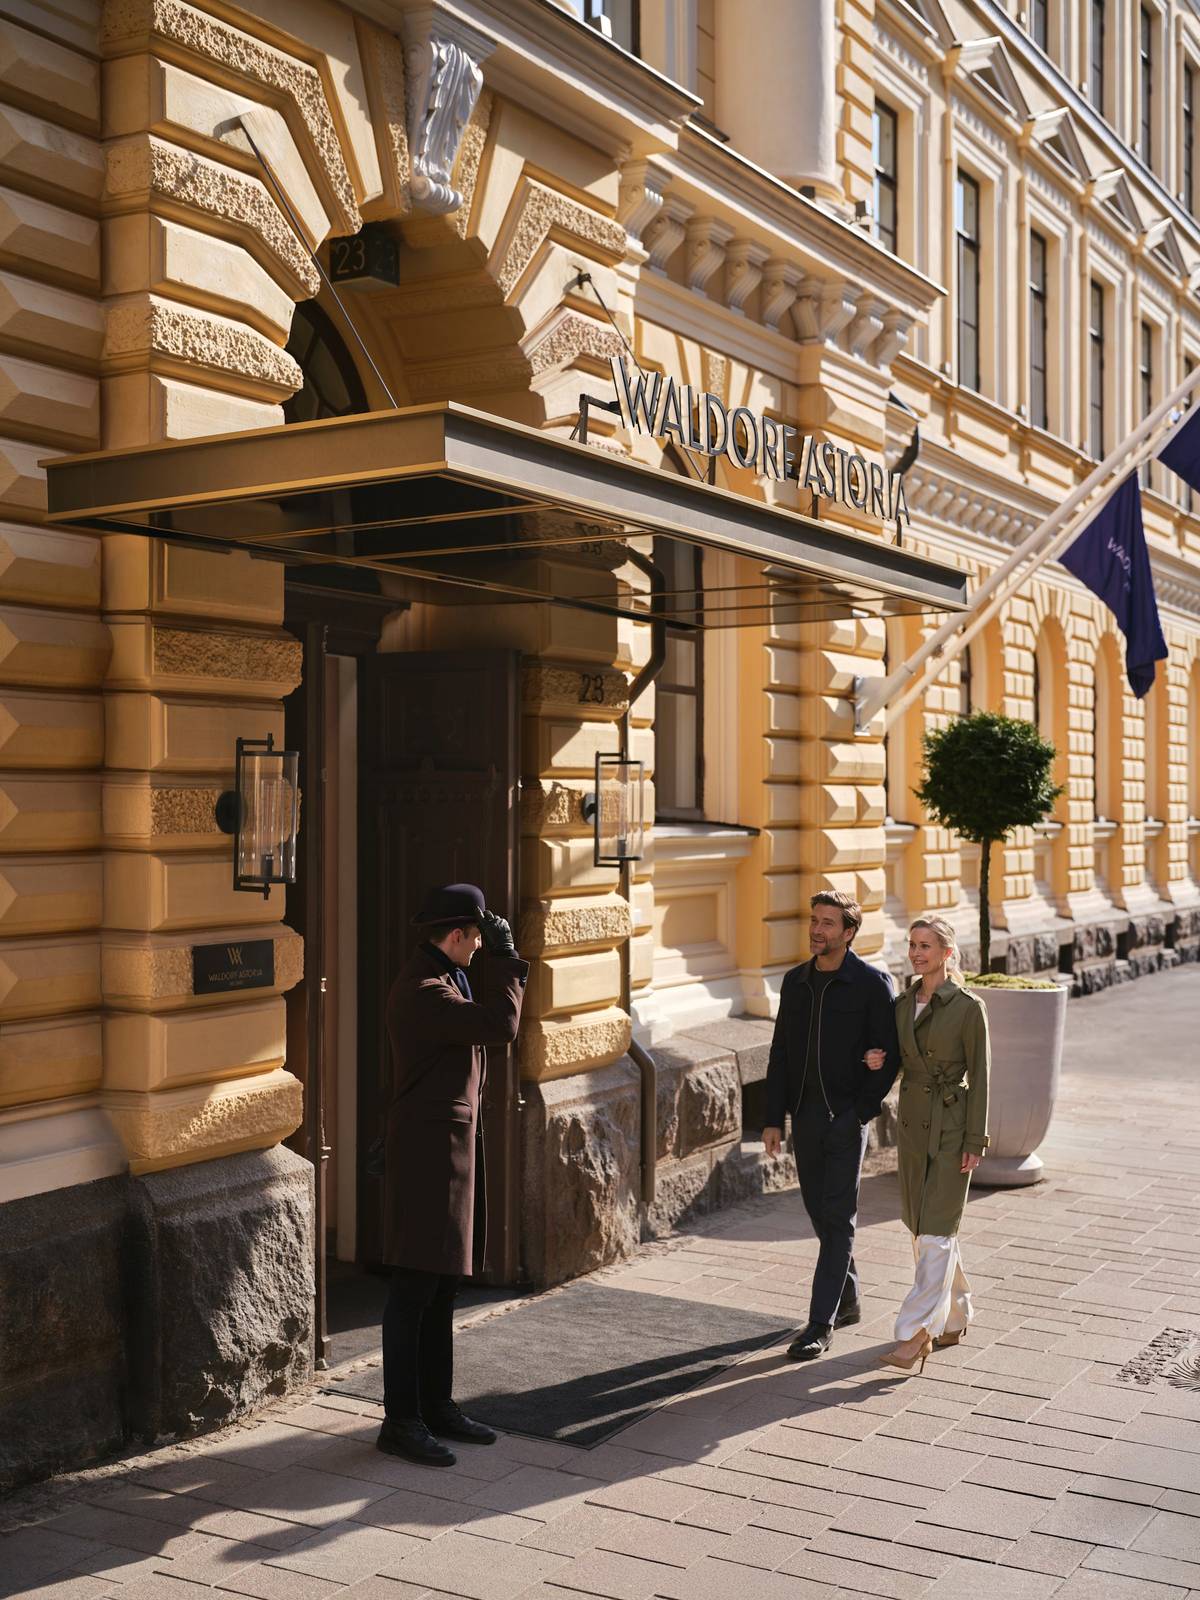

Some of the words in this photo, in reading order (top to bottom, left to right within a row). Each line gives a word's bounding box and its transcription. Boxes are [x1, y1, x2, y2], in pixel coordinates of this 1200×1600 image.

[335, 239, 366, 275] 23
[609, 356, 797, 482] WALDORF
[796, 434, 910, 526] ASTORIA
[578, 673, 605, 704] 23
